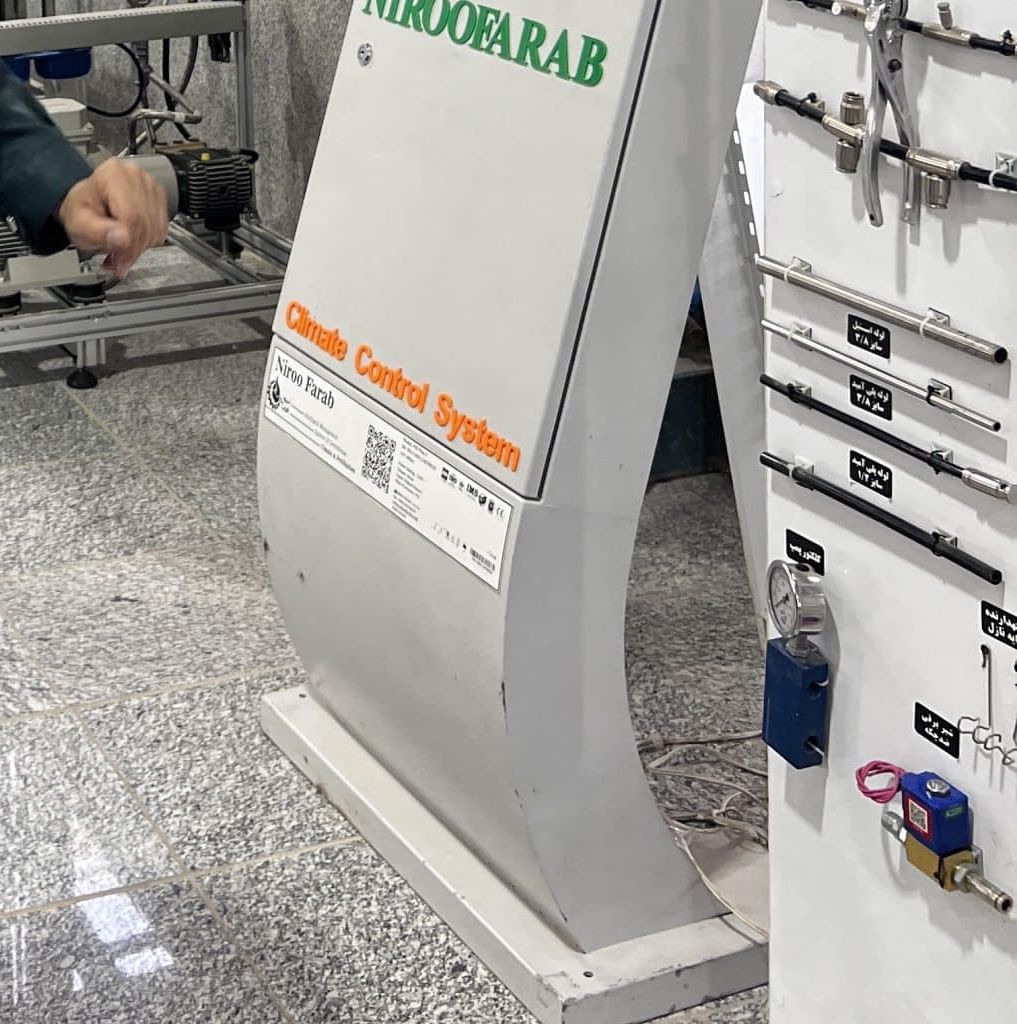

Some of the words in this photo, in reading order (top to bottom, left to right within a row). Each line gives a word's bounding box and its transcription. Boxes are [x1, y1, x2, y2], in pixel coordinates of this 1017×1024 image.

[275, 354, 303, 387] Niroo
[304, 375, 335, 409] Farab
[285, 300, 348, 362] Climate
[355, 343, 430, 414] Control
[434, 392, 521, 473] System
